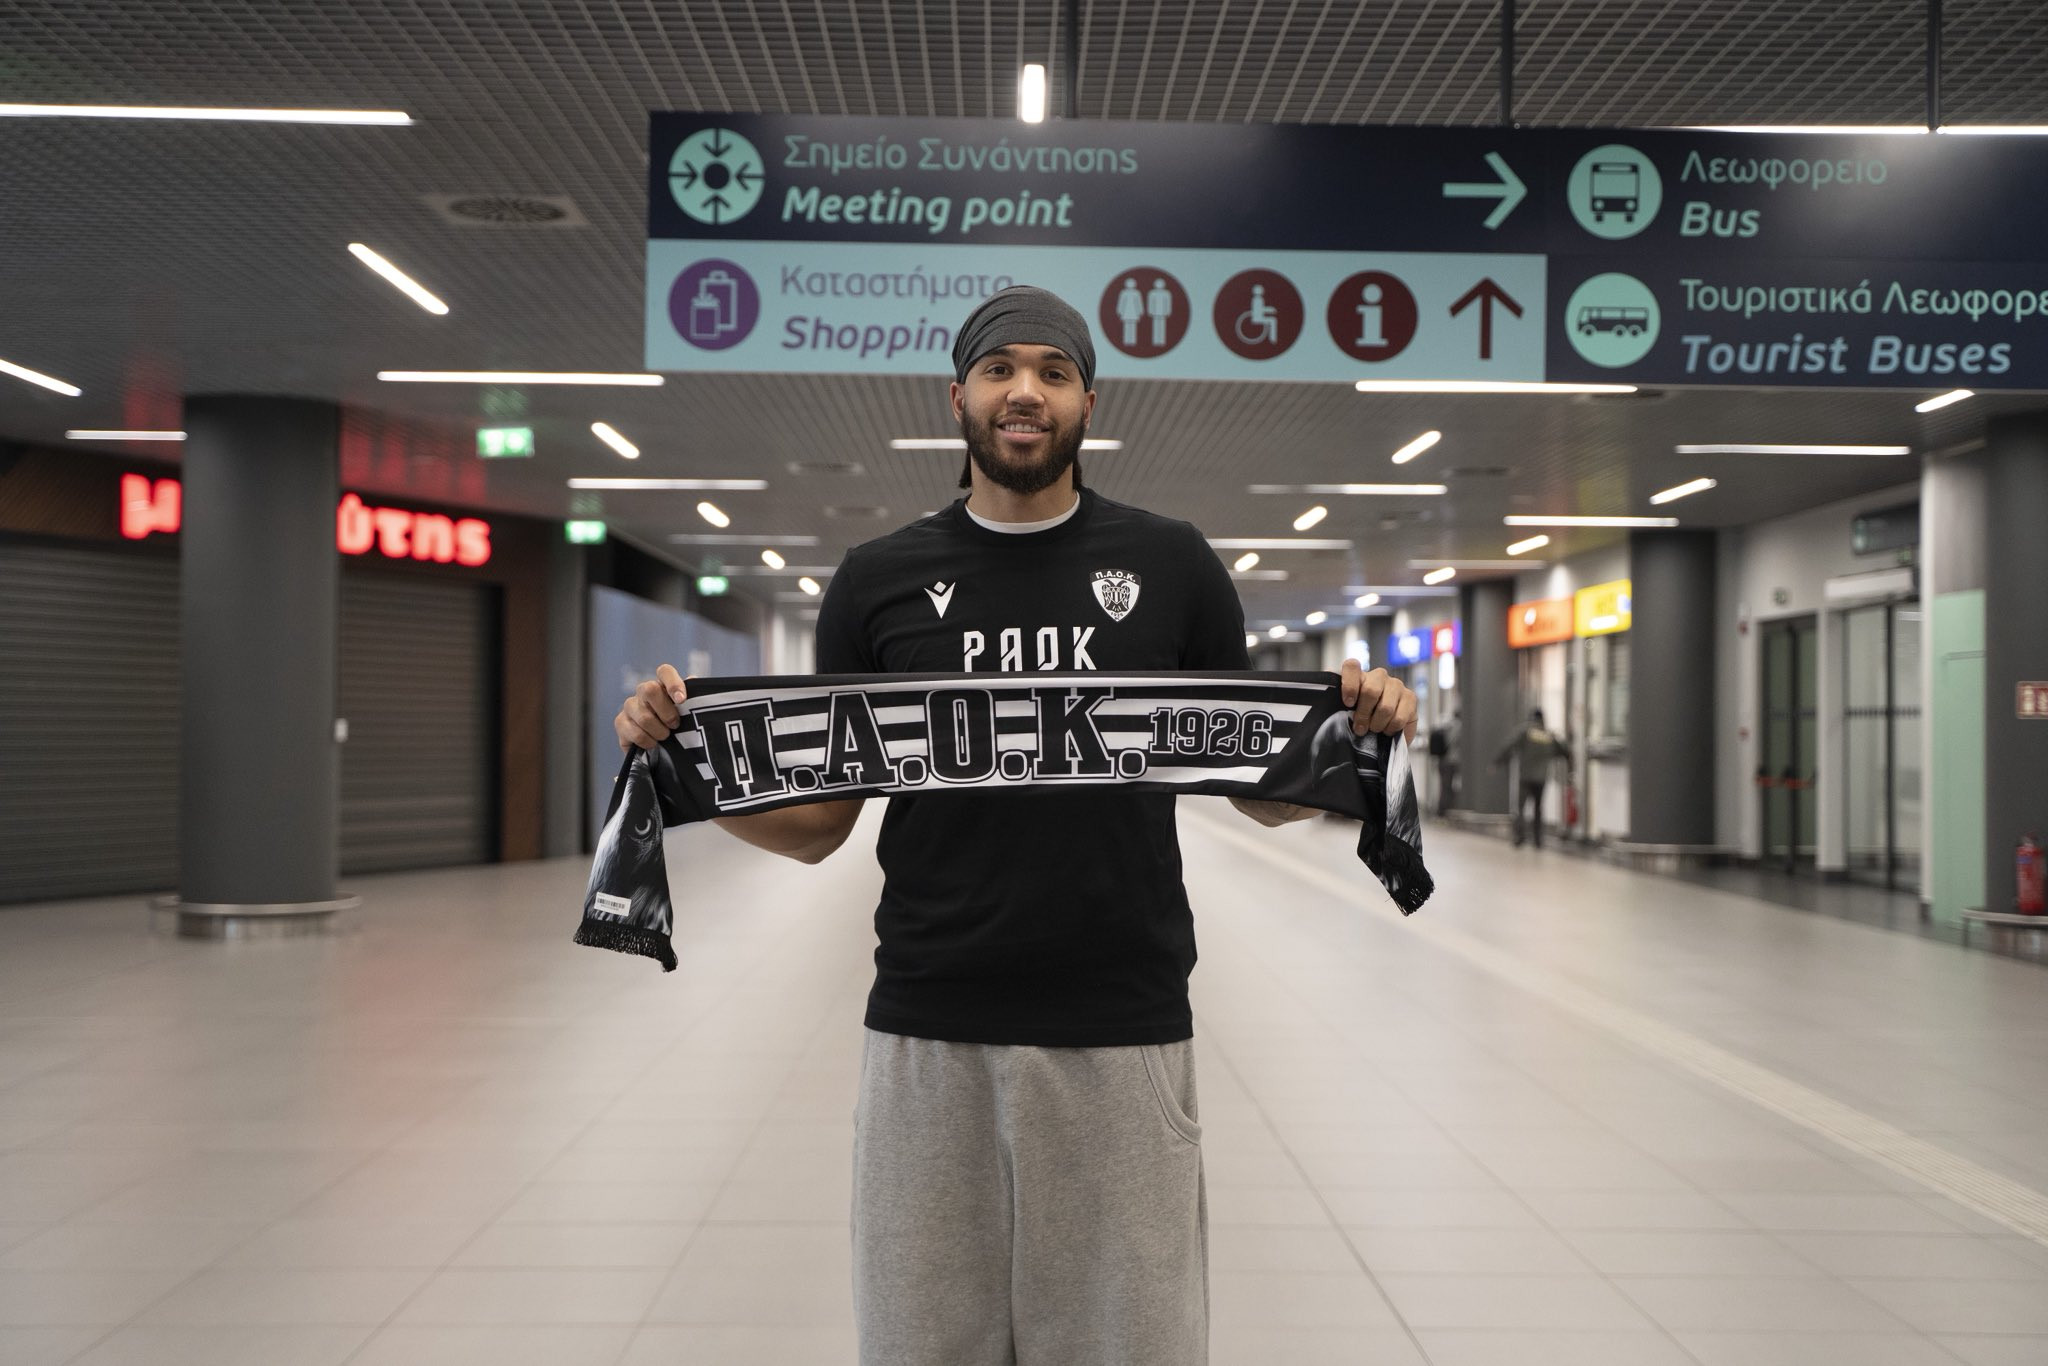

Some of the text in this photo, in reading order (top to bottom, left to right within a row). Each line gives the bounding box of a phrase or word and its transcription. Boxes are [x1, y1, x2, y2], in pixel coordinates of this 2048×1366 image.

[783, 134, 1138, 176] Σημείο Συνάντησης
[782, 186, 1073, 234] Meeting point
[1680, 202, 1760, 237] Bus
[1679, 277, 1872, 319] Τουριστικά
[782, 316, 956, 359] Shoppin
[1680, 332, 2012, 375] Tourist Buses
[1147, 706, 1274, 759] 1926
